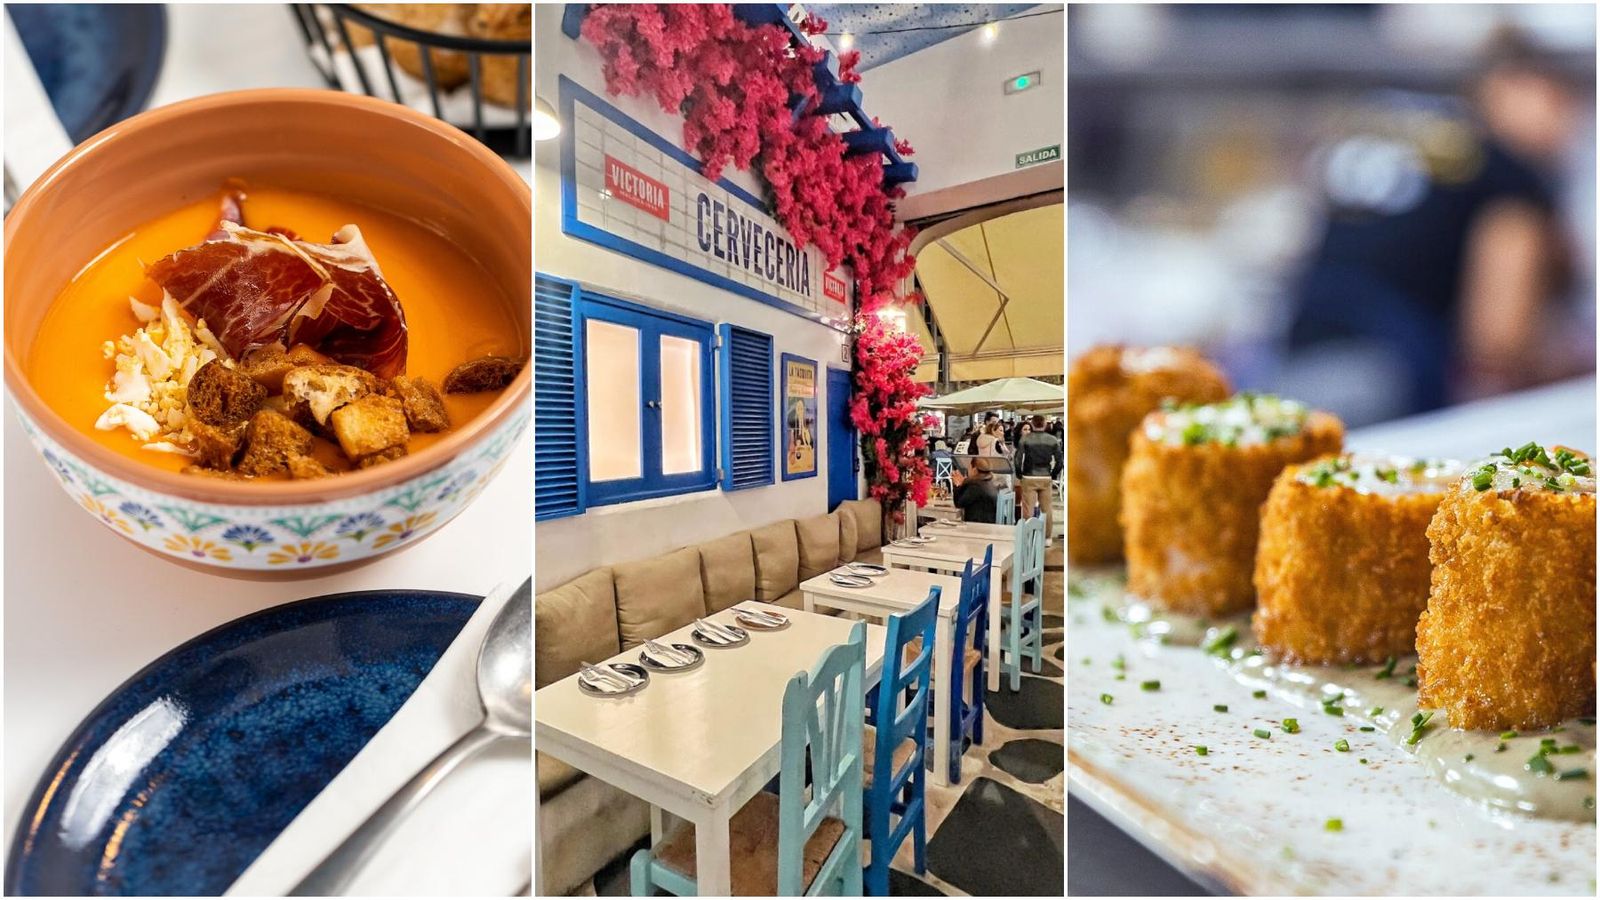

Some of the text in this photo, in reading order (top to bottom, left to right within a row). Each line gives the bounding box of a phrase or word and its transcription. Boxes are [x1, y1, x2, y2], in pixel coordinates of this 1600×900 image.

[1019, 149, 1057, 165] SALIDA
[611, 163, 665, 209] VICTORIA
[697, 192, 811, 297] CERVECERIA
